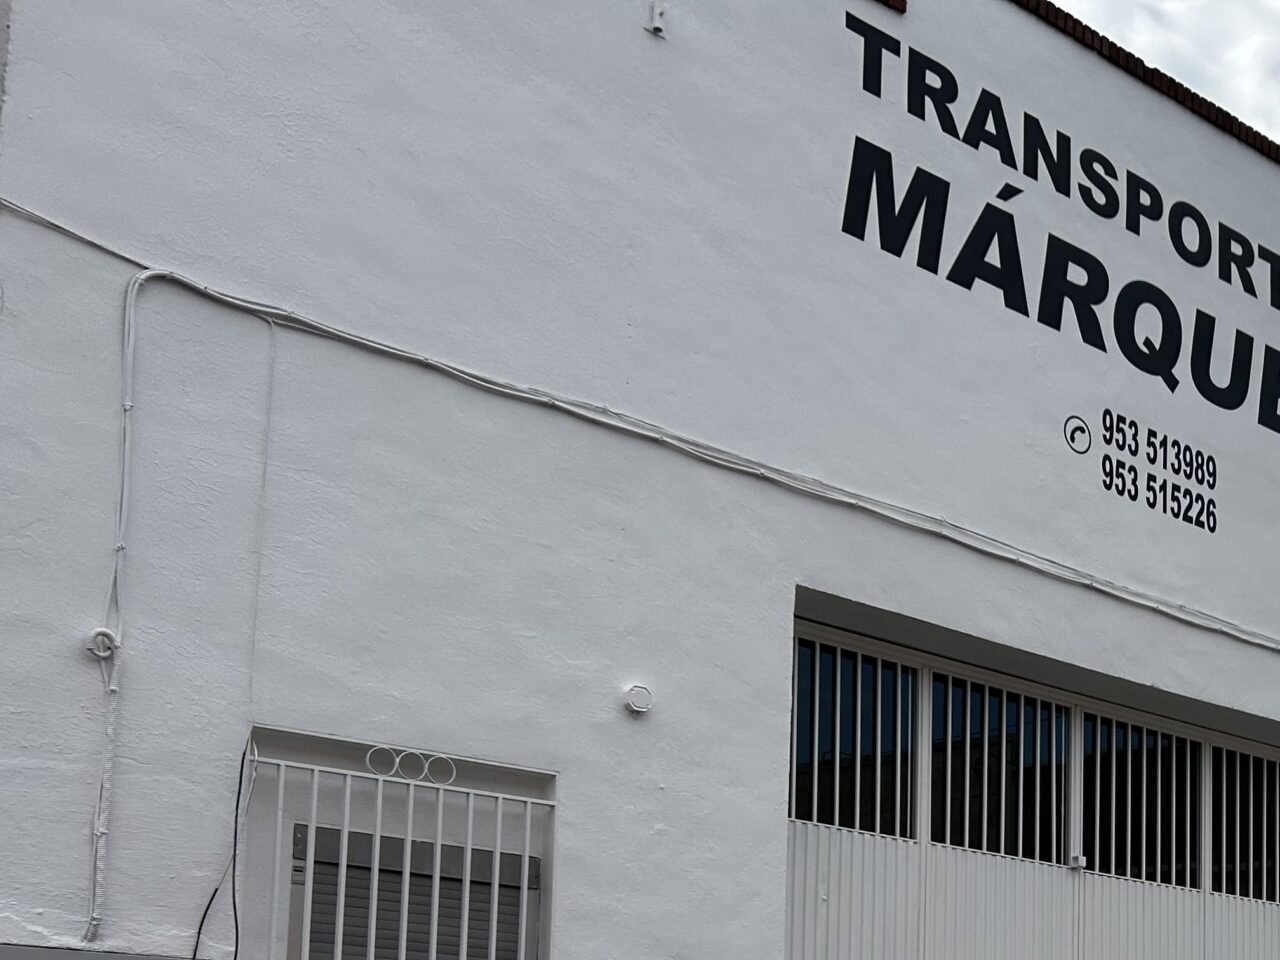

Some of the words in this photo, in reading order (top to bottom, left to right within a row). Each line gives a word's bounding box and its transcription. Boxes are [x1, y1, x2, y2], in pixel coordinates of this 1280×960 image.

[1102, 408, 1139, 457] 953
[1146, 427, 1217, 491] 513989
[1101, 454, 1139, 502] 953
[1146, 472, 1217, 534] 515226
